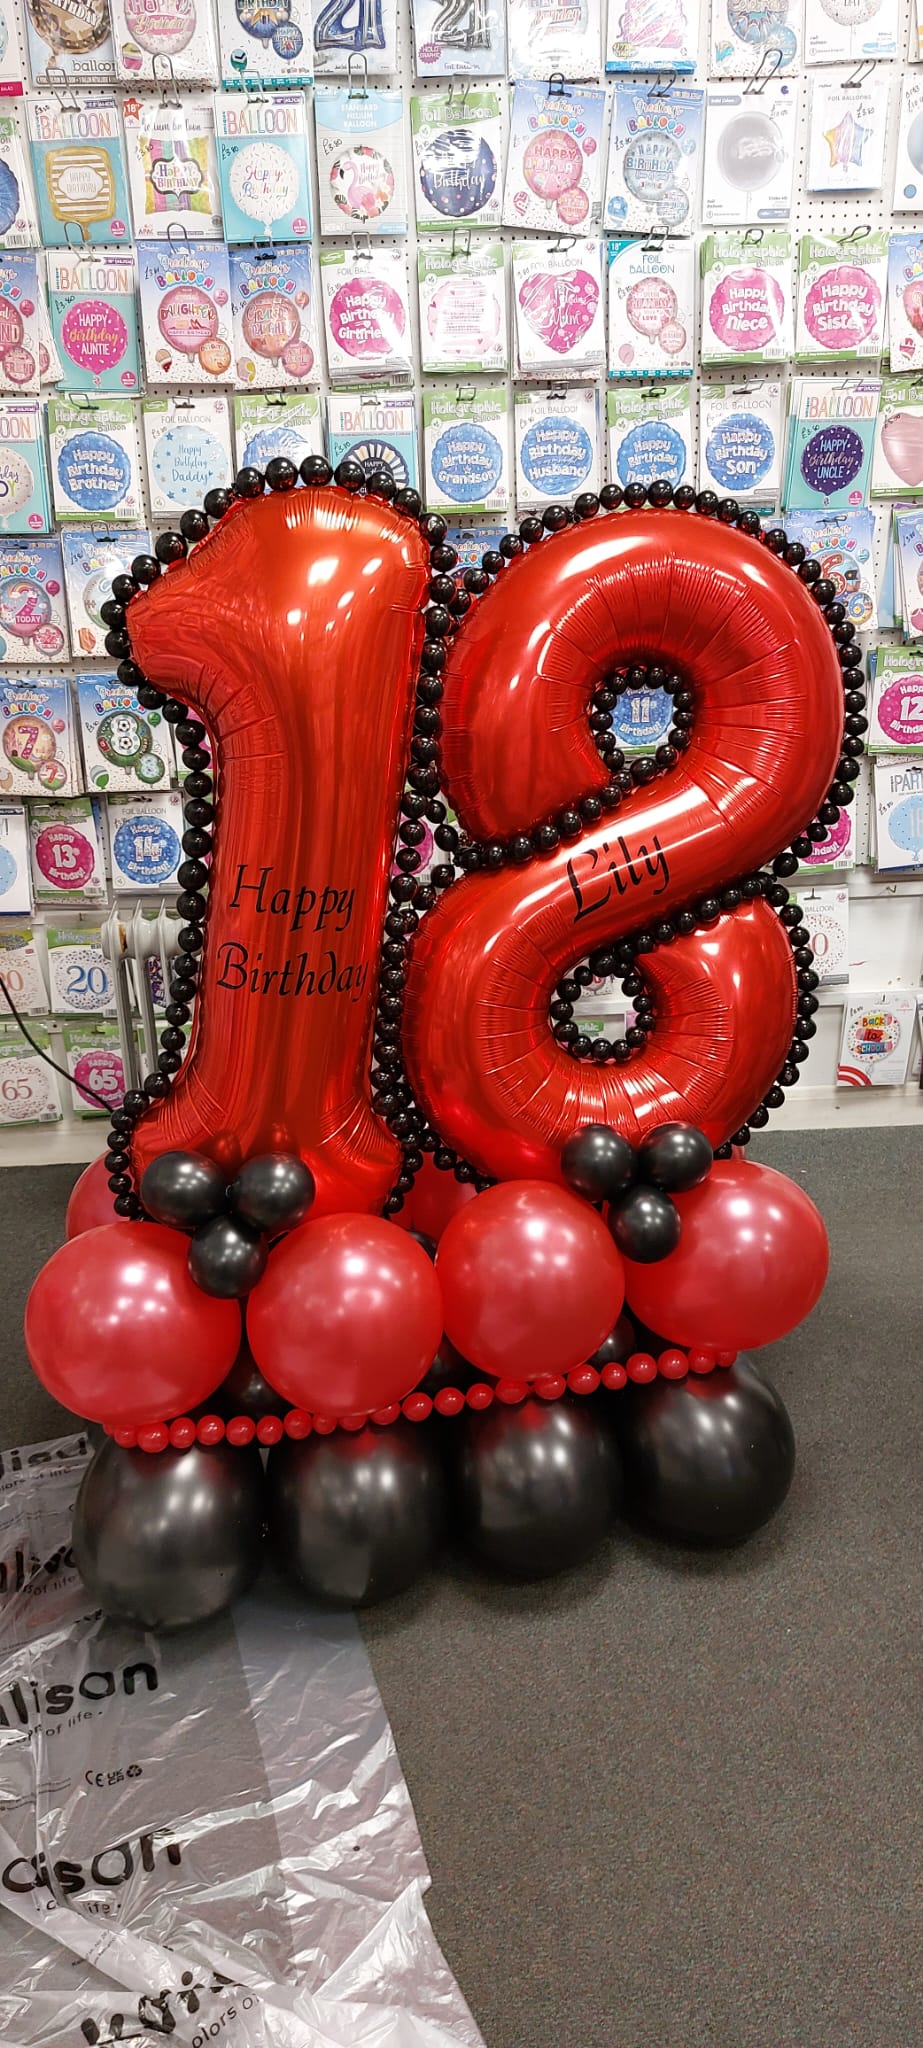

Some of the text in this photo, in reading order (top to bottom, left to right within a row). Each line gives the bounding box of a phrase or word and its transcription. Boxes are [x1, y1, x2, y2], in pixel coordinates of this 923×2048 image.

[40, 115, 112, 139] BALLOON
[227, 109, 299, 135] BALLOON
[528, 113, 586, 136] BALLOON
[628, 115, 686, 136] BALLOON
[534, 146, 578, 160] HAPPY
[626, 157, 675, 171] BIRTHDA
[642, 254, 662, 265] FOIL
[629, 264, 675, 275] BALLOON
[60, 267, 129, 291] BALLOON
[156, 270, 214, 290] BALLOON
[239, 275, 296, 298] BALLOON
[729, 287, 768, 300] Happy
[821, 284, 868, 299] Happy
[160, 303, 217, 321] DAUGHTER
[722, 301, 771, 315] Birthda
[812, 299, 875, 316] Birthday
[79, 313, 108, 328] HAPPY
[69, 327, 119, 346] Birthday
[81, 343, 111, 356] AUNTIE
[531, 407, 545, 415] FOIL
[710, 400, 772, 411] FOIL BALLOON
[809, 396, 873, 418] BALLOON
[161, 414, 213, 424] FOIL BALLOON
[344, 411, 404, 432] BALLOON
[536, 429, 579, 443] Happy
[721, 431, 762, 446] Happy
[178, 444, 202, 456] Happy
[447, 442, 487, 454] Happy
[528, 443, 587, 460] Birthday
[633, 439, 672, 452] Happy
[716, 445, 768, 461] Birthday
[820, 439, 848, 452] HAPPY
[72, 449, 115, 463] Happy
[174, 457, 208, 470] Birthday
[627, 452, 678, 467] Birthday
[808, 450, 855, 467] Birthday
[67, 462, 124, 480] Birthday
[364, 460, 384, 468] HAPPY
[441, 456, 494, 472] Birthday
[528, 463, 587, 480] Husband
[725, 459, 758, 475] Son
[172, 469, 210, 485] Daddy
[438, 470, 497, 485] Grandson
[816, 466, 845, 479] UNCLE
[69, 477, 123, 492] Brother
[16, 615, 41, 625] TODAY
[3, 703, 52, 720] BALLOON
[110, 714, 140, 756] 8
[18, 726, 38, 761] 7
[122, 807, 167, 815] FOIL BALLOON
[130, 824, 161, 835] Happy
[49, 833, 75, 843] Happy
[566, 834, 671, 925] Lily
[228, 863, 356, 933] Happy
[804, 905, 835, 913] BALLOON
[66, 965, 109, 995] 20
[216, 942, 370, 1003] Birthday
[863, 1016, 885, 1027] BACK
[867, 1032, 878, 1042] to
[88, 1069, 118, 1091] 65
[2, 1078, 33, 1101] 65
[68, 1711, 93, 1728] life
